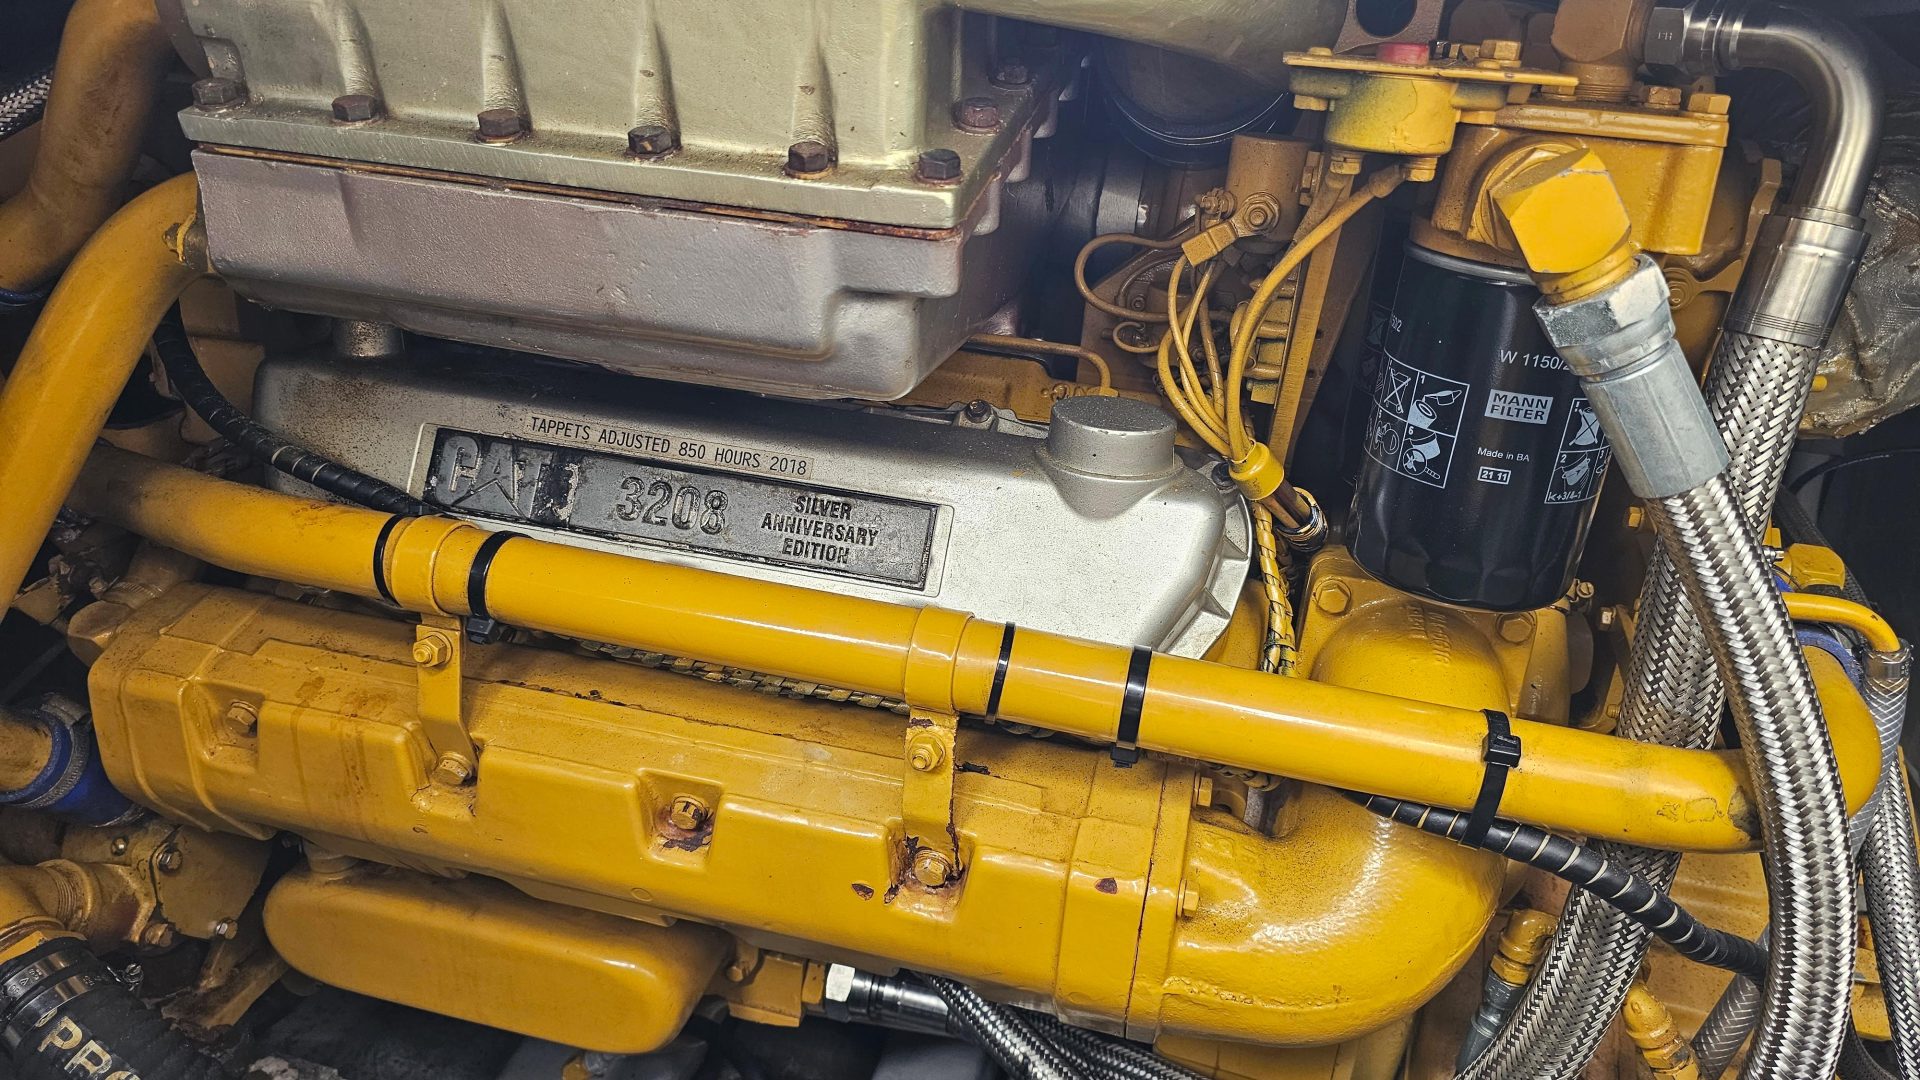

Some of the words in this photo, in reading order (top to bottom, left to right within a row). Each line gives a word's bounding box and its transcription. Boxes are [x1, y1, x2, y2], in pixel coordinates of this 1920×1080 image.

[1500, 349, 1518, 364] W
[1420, 374, 1426, 385] 1
[1493, 392, 1549, 410] MANN
[1489, 404, 1545, 421] FILTER
[1408, 425, 1414, 435] 6
[531, 416, 591, 441] TAPPETS
[597, 428, 671, 454] ADJUSTED
[678, 441, 706, 460] 850
[714, 447, 761, 468] HOURS
[770, 455, 807, 476] 2018
[1477, 446, 1504, 459] Made
[1506, 451, 1514, 460] in
[1516, 453, 1530, 462] BA
[1560, 453, 1567, 463] 2
[434, 435, 554, 519] CAT
[1481, 469, 1494, 479] 21
[1497, 472, 1508, 481] 11
[615, 476, 729, 535] 3208
[794, 495, 852, 521] SILVER
[760, 512, 879, 547] ANNIVERSARY
[781, 537, 849, 564] EDITION
